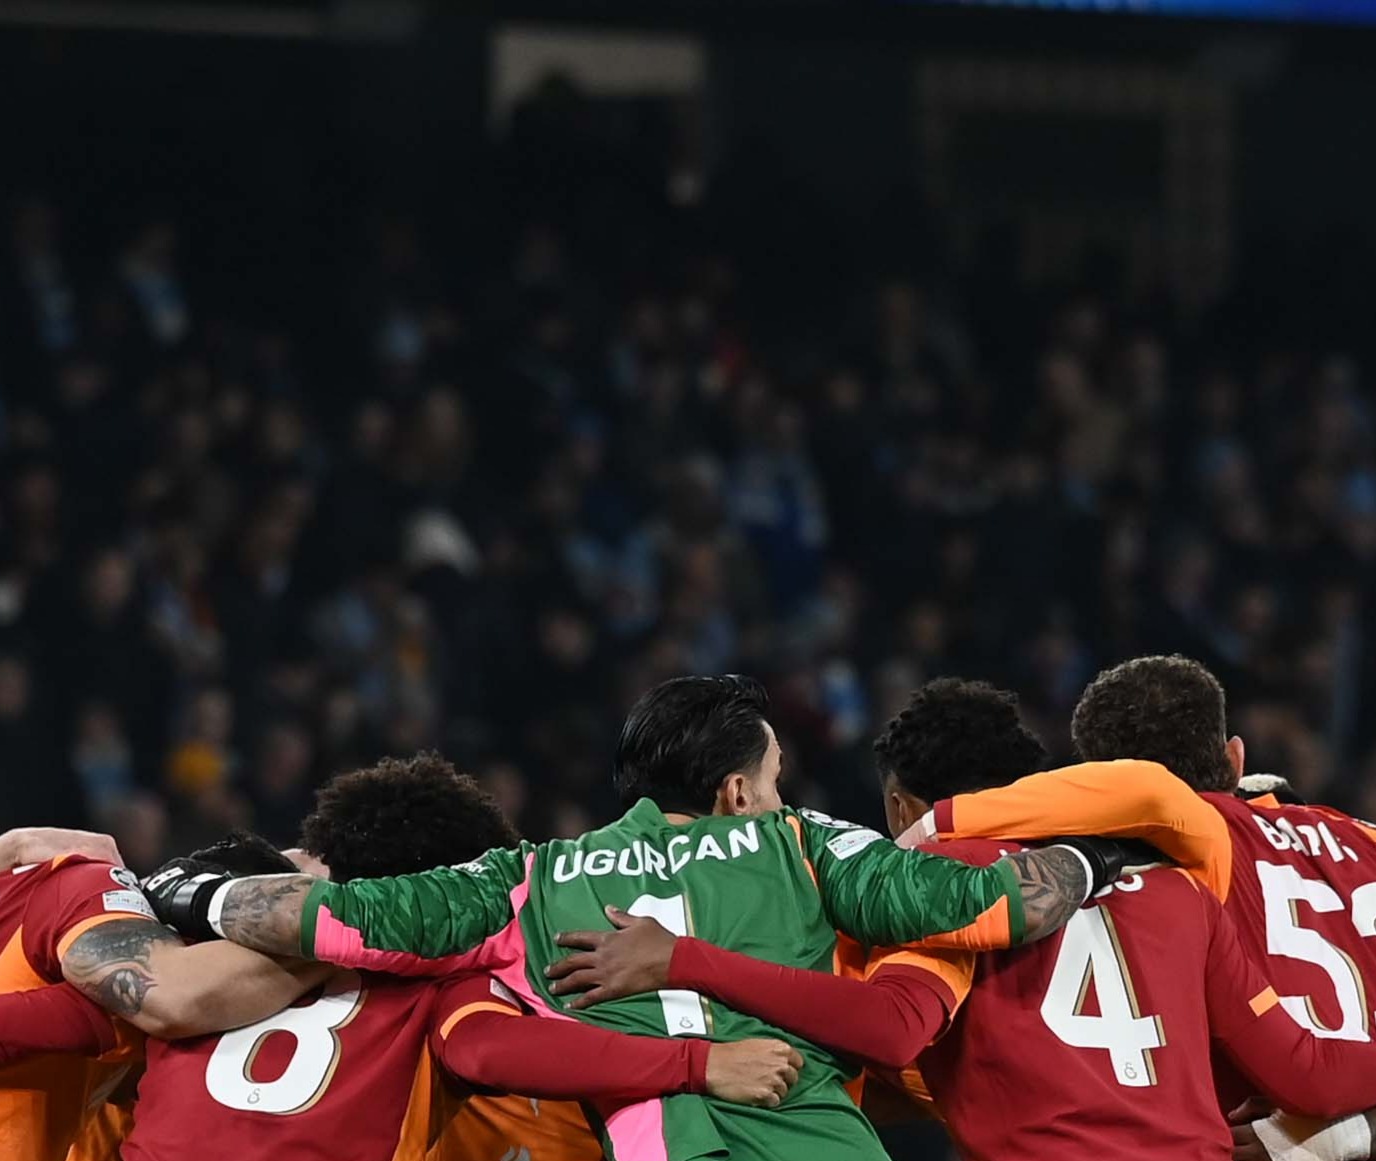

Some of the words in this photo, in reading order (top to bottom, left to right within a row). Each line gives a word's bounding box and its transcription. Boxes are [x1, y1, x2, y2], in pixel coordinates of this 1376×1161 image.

[553, 821, 760, 883] UGURCAN
[205, 990, 364, 1116] 8
[1040, 902, 1166, 1086] 4
